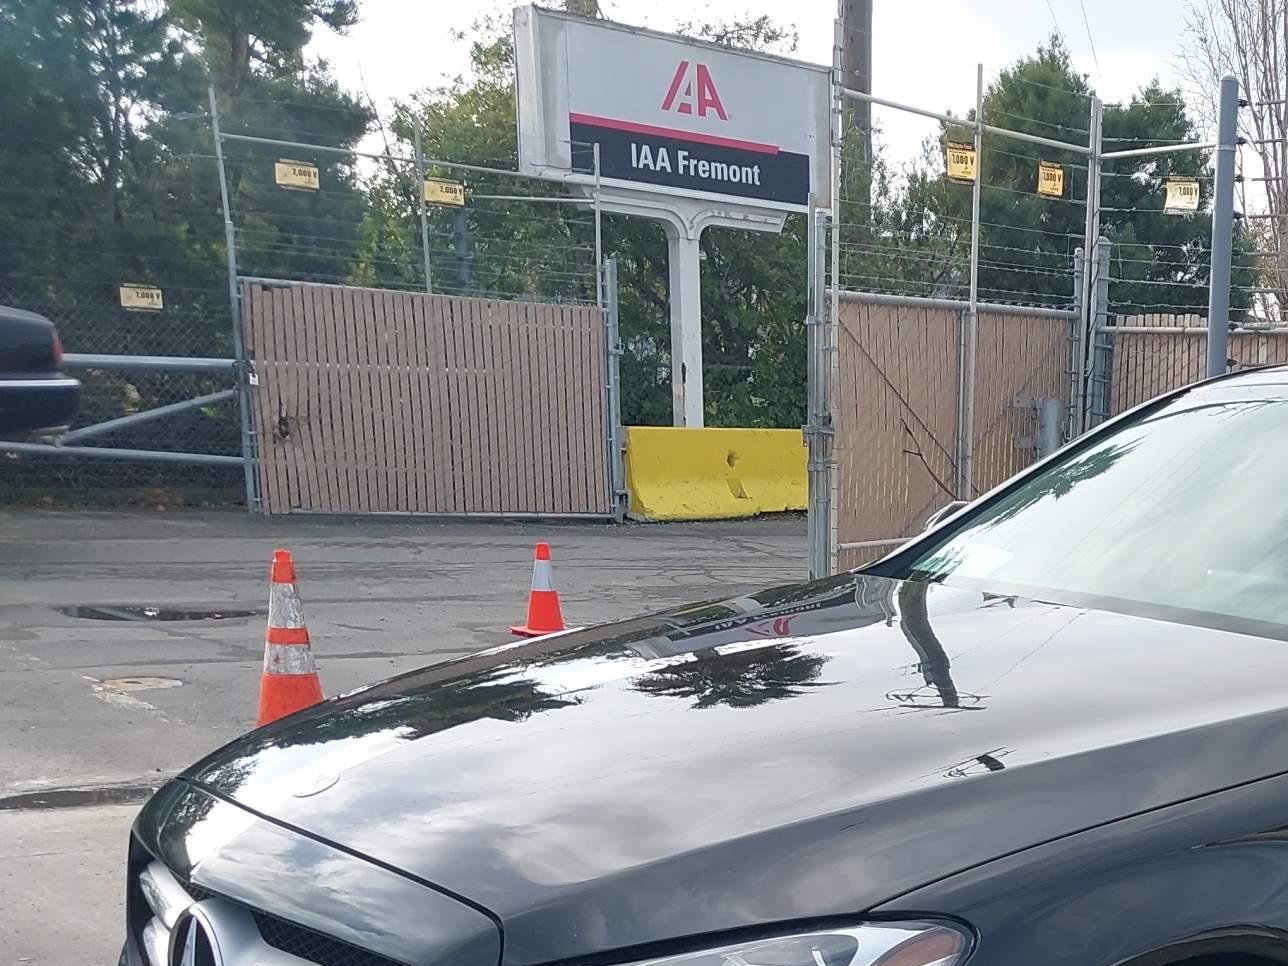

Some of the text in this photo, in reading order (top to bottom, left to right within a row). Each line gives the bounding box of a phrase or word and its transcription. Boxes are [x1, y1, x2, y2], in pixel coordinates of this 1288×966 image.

[631, 143, 761, 186] IAA Fremont
[952, 153, 969, 165] 7,000
